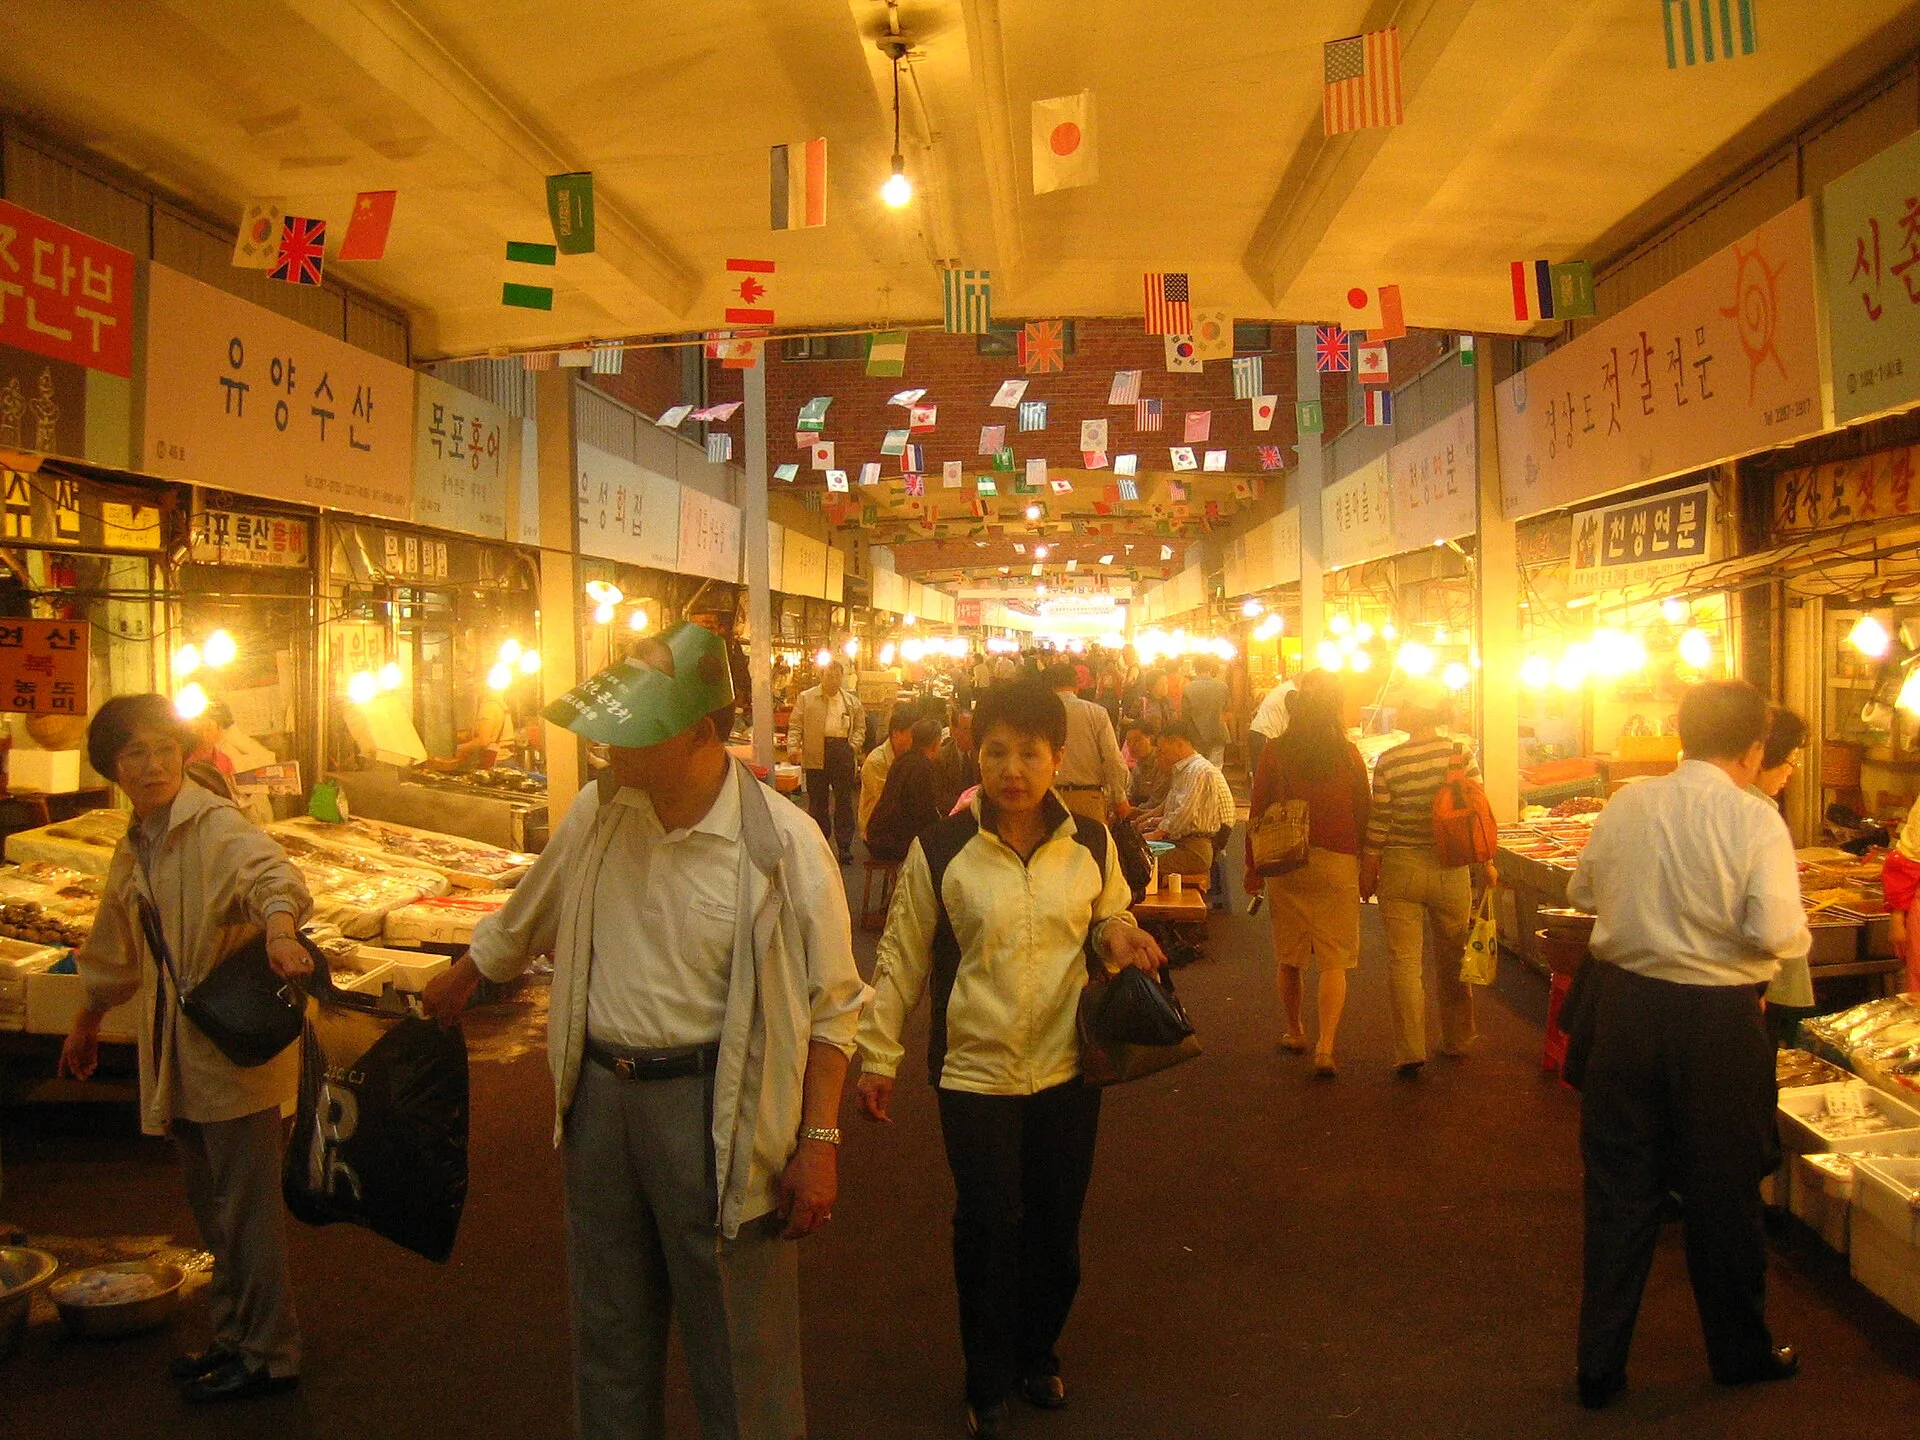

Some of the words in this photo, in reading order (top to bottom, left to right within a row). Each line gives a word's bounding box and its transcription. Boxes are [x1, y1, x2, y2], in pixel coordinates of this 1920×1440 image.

[219, 336, 374, 452] 유양수산
[1601, 330, 1655, 437] 젓갈
[1666, 326, 1713, 407] 전문
[428, 402, 500, 478] 목포홍어
[1607, 500, 1697, 559] 천생연분
